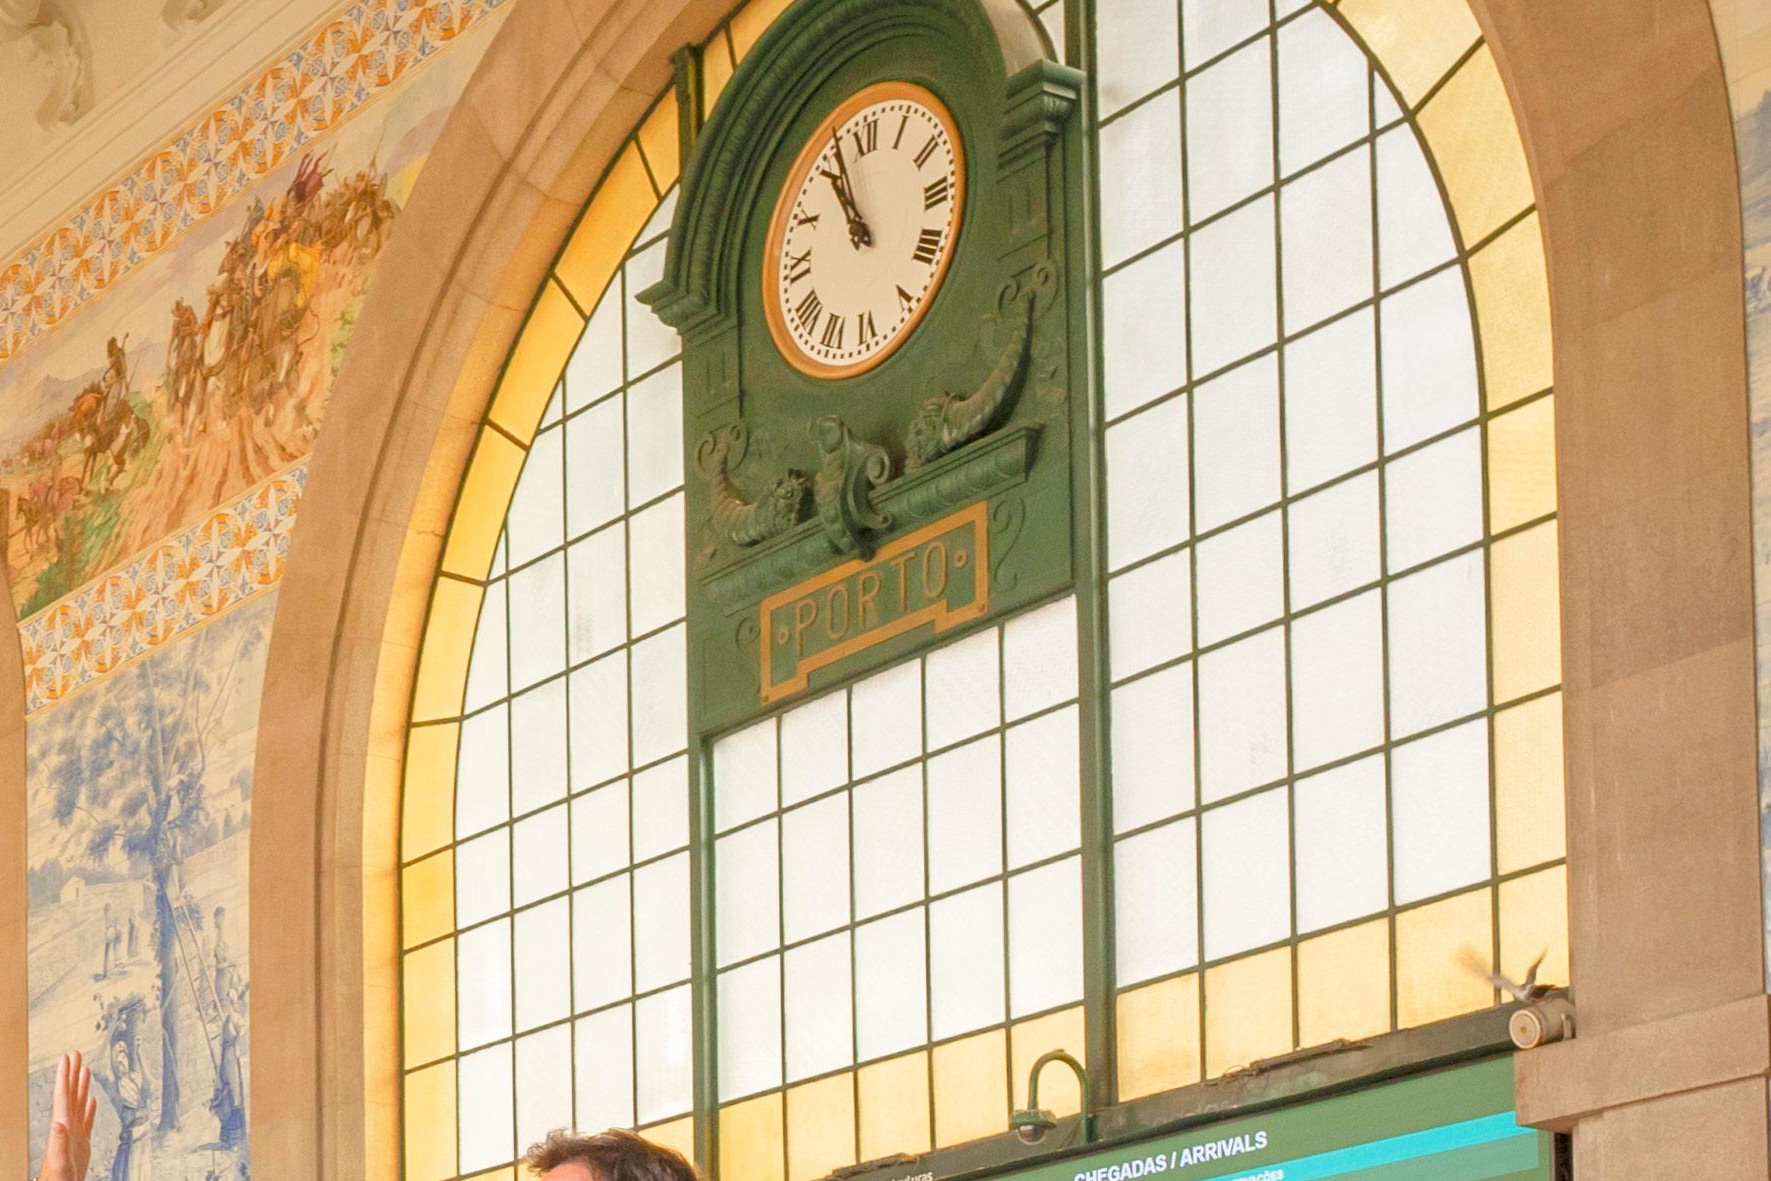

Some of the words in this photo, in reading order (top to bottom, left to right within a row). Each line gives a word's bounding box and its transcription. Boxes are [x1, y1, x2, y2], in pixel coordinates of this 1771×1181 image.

[796, 541, 947, 656] PORTO
[1170, 1151, 1177, 1169] /
[1179, 1131, 1268, 1167] ARRIVALS
